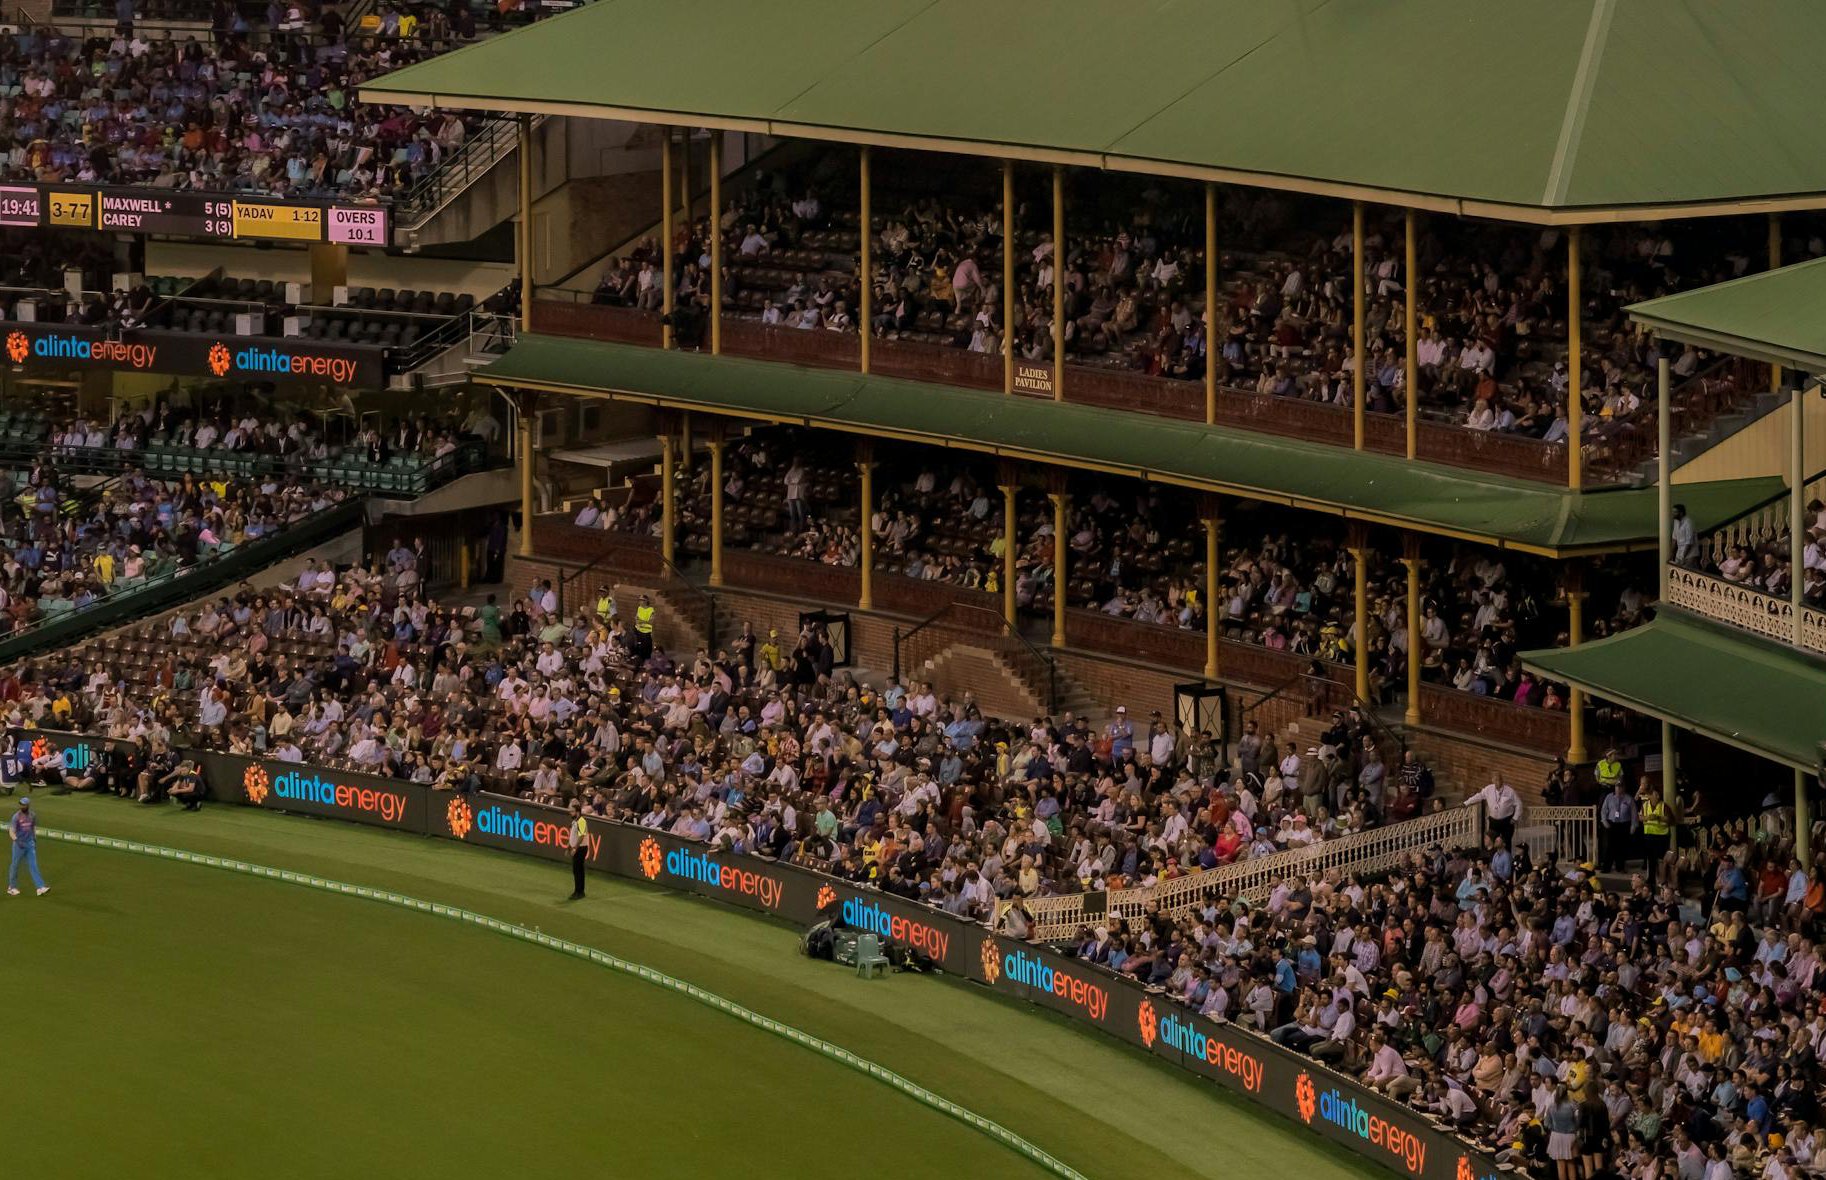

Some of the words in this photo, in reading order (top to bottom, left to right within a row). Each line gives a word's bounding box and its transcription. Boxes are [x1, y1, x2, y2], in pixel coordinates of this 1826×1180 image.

[1, 199, 40, 216] 19:41
[52, 202, 90, 219] 3-77
[103, 197, 162, 213] MAXWELL
[204, 202, 213, 215] 5
[215, 203, 232, 218] (5)
[237, 207, 274, 220] YADAV
[293, 210, 319, 223] 1-12
[103, 213, 142, 227] CAREY
[204, 220, 213, 233] 3
[215, 221, 232, 236] (3)
[337, 211, 376, 225] OVERS
[347, 228, 374, 241] 10.1
[1019, 367, 1048, 380] LADIES
[1015, 377, 1052, 391] PAVILION
